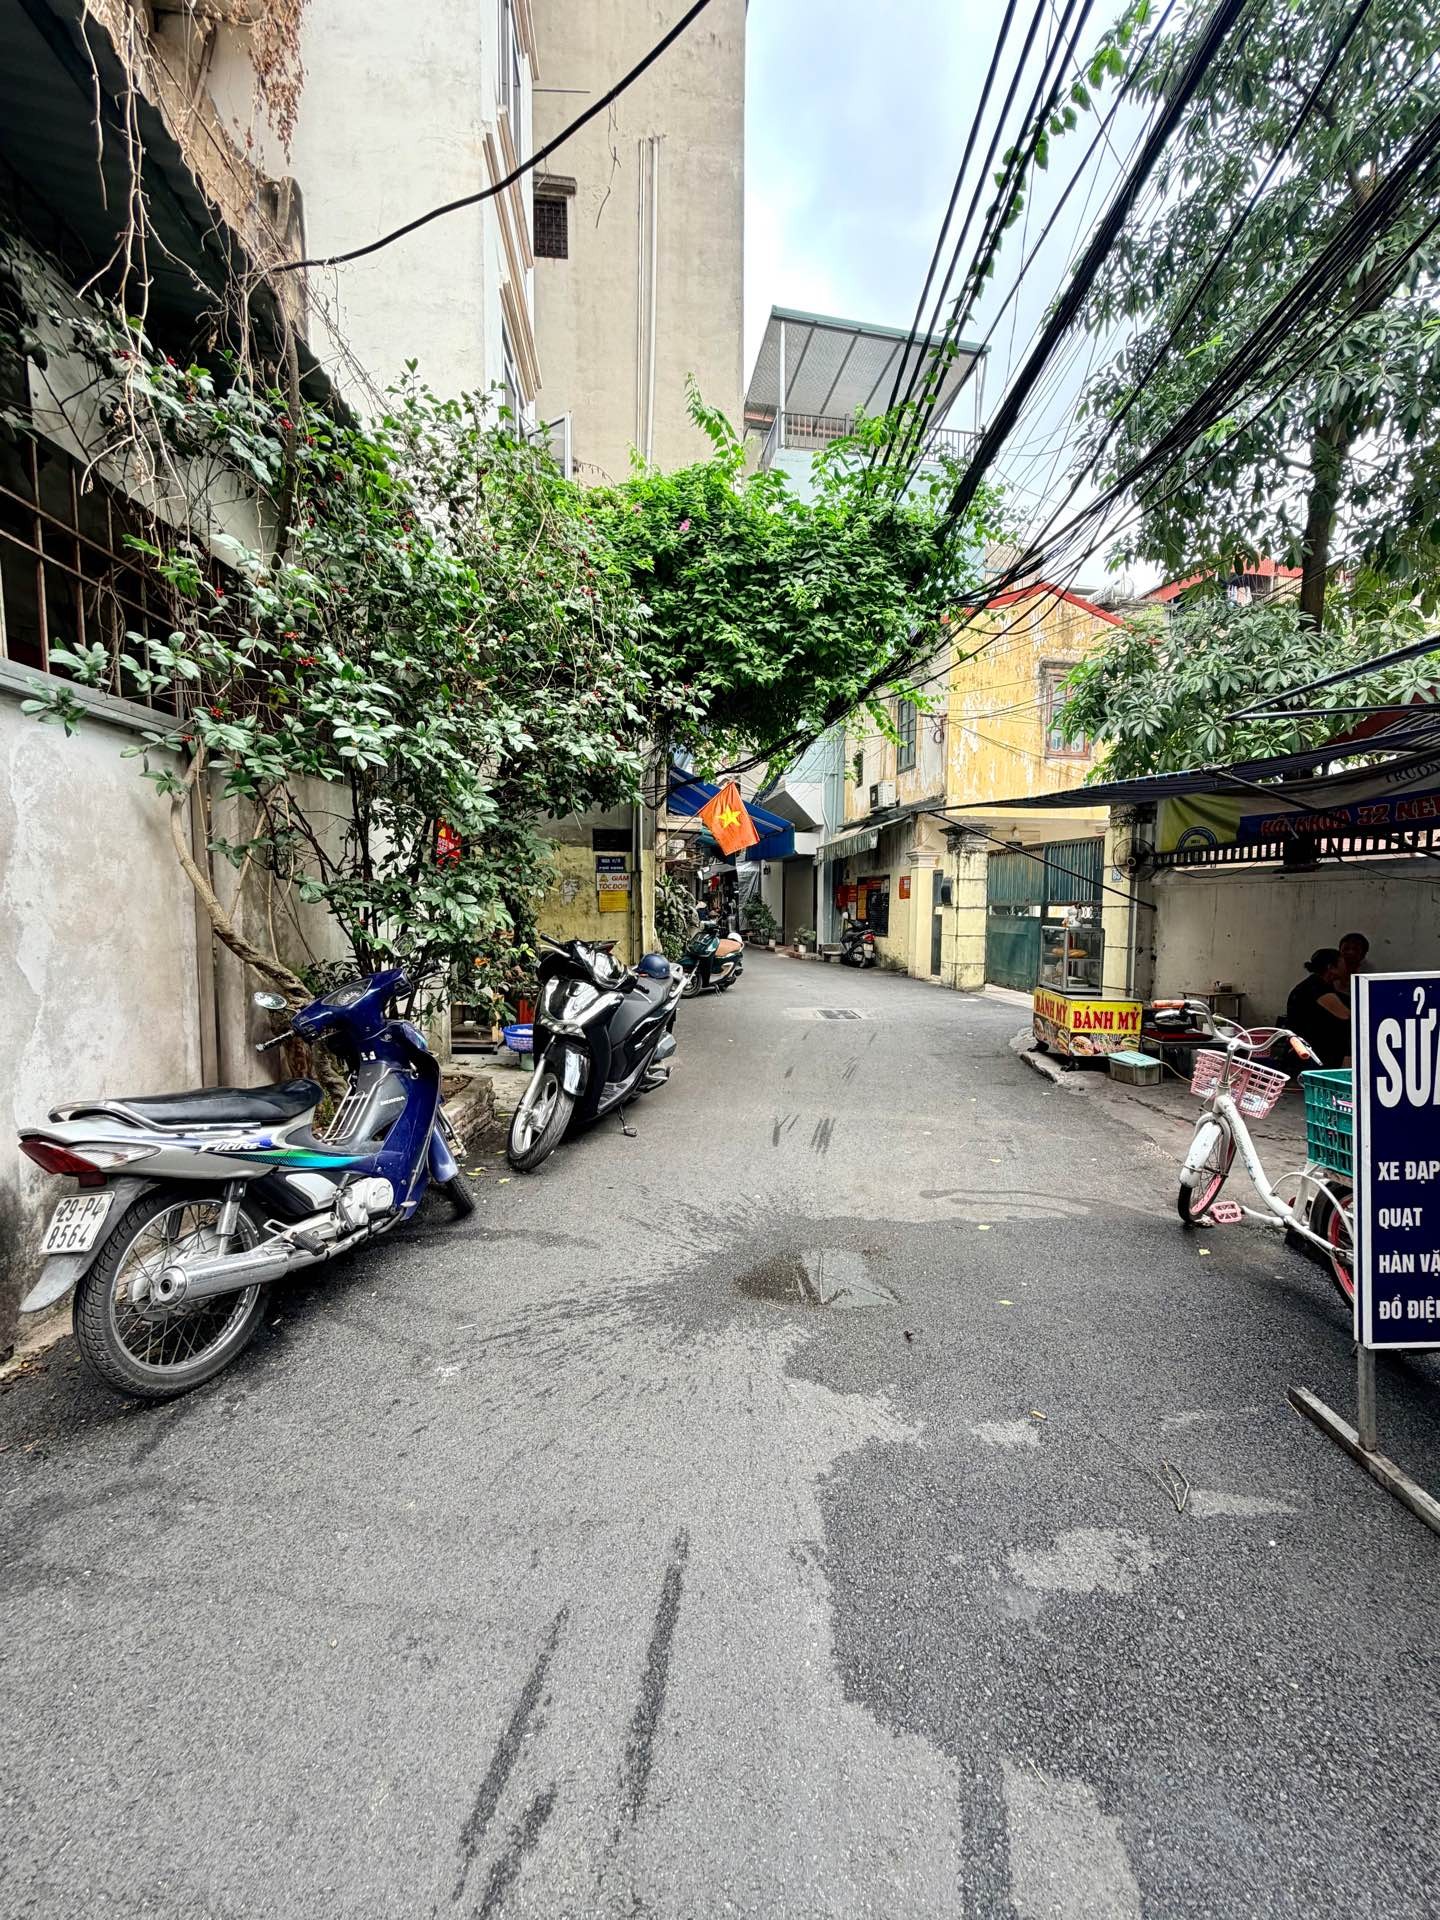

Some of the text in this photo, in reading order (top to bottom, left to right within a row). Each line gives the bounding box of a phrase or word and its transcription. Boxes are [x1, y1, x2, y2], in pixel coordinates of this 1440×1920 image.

[1036, 992, 1055, 1015] BÁNH
[1073, 1005, 1113, 1029] BÁNH
[1376, 986, 1440, 1108] SỬ
[1378, 1160, 1440, 1185] XE ĐẠP
[56, 1196, 103, 1223] 29-P4
[1378, 1207, 1423, 1231] QUẠT
[47, 1224, 91, 1250] 8564
[1379, 1250, 1415, 1274] HÀN
[1379, 1294, 1402, 1320] ĐỒ
